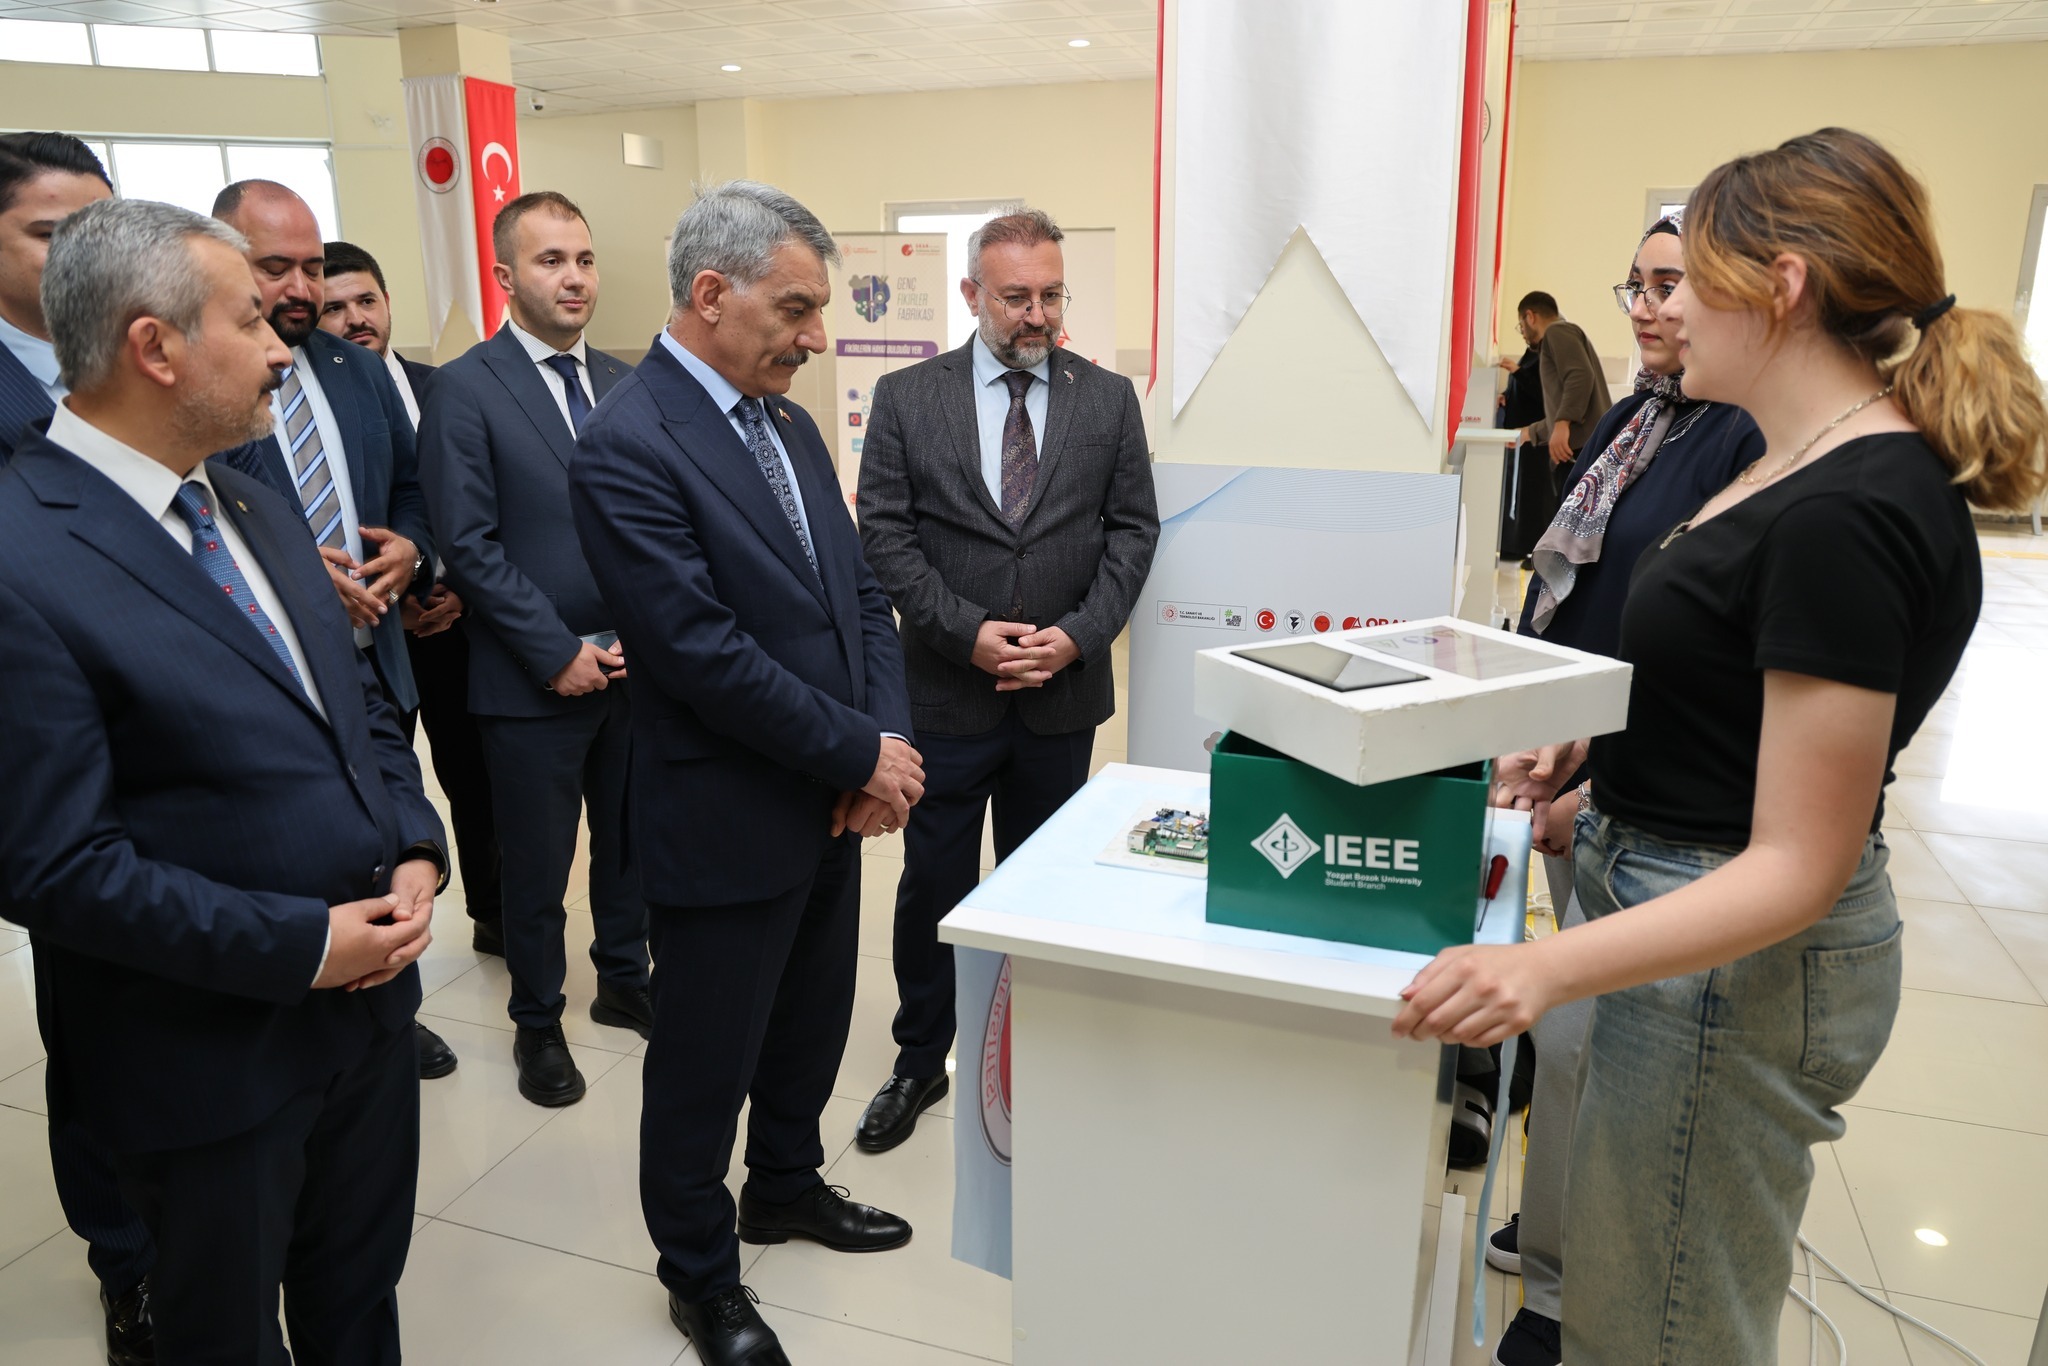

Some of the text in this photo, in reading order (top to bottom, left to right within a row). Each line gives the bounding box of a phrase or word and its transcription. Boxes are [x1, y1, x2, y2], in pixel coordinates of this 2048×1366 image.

[897, 277, 917, 291] GENÇ
[1325, 834, 1419, 871] IEEE
[1324, 879, 1386, 890] Student Branch
[1325, 871, 1422, 887] Yozgat Bozok University
